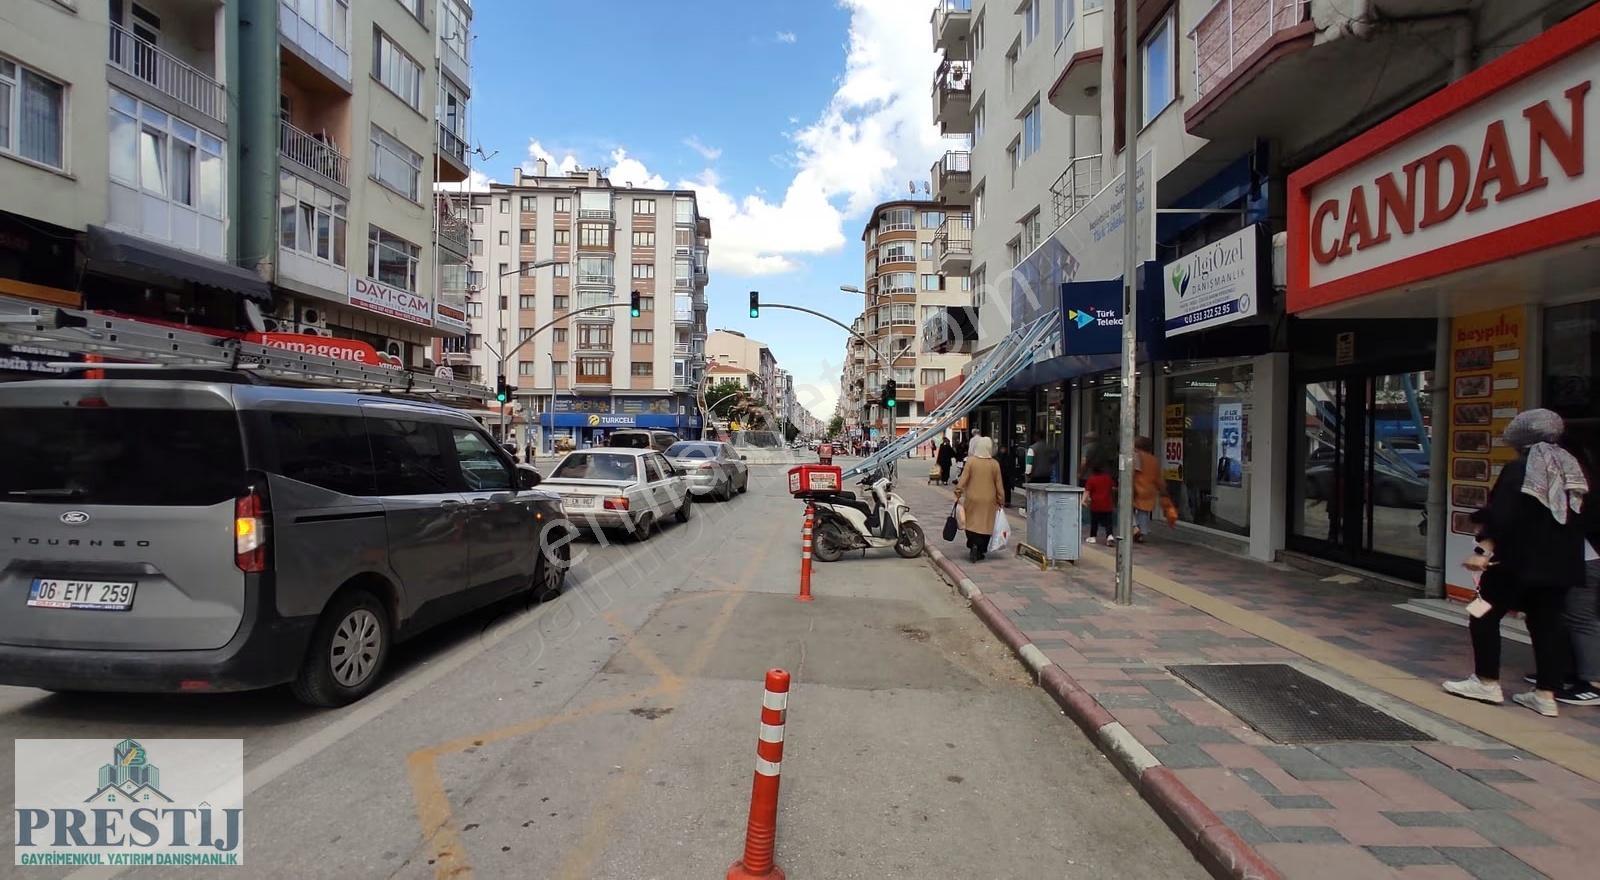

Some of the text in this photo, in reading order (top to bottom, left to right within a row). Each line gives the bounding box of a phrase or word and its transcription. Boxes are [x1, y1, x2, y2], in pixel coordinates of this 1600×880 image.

[1311, 80, 1591, 264] CANDAN
[1193, 313, 1203, 322] 531
[1203, 309, 1213, 319] 322
[1214, 306, 1222, 316] 52
[1222, 303, 1230, 314] 95
[1096, 318, 1124, 326] Teleko
[261, 335, 365, 362] komagene
[601, 416, 634, 424] TURKCELL
[1166, 442, 1182, 460] 550
[12, 537, 150, 547] TOURNEO
[39, 582, 129, 602] 06 EYY 259
